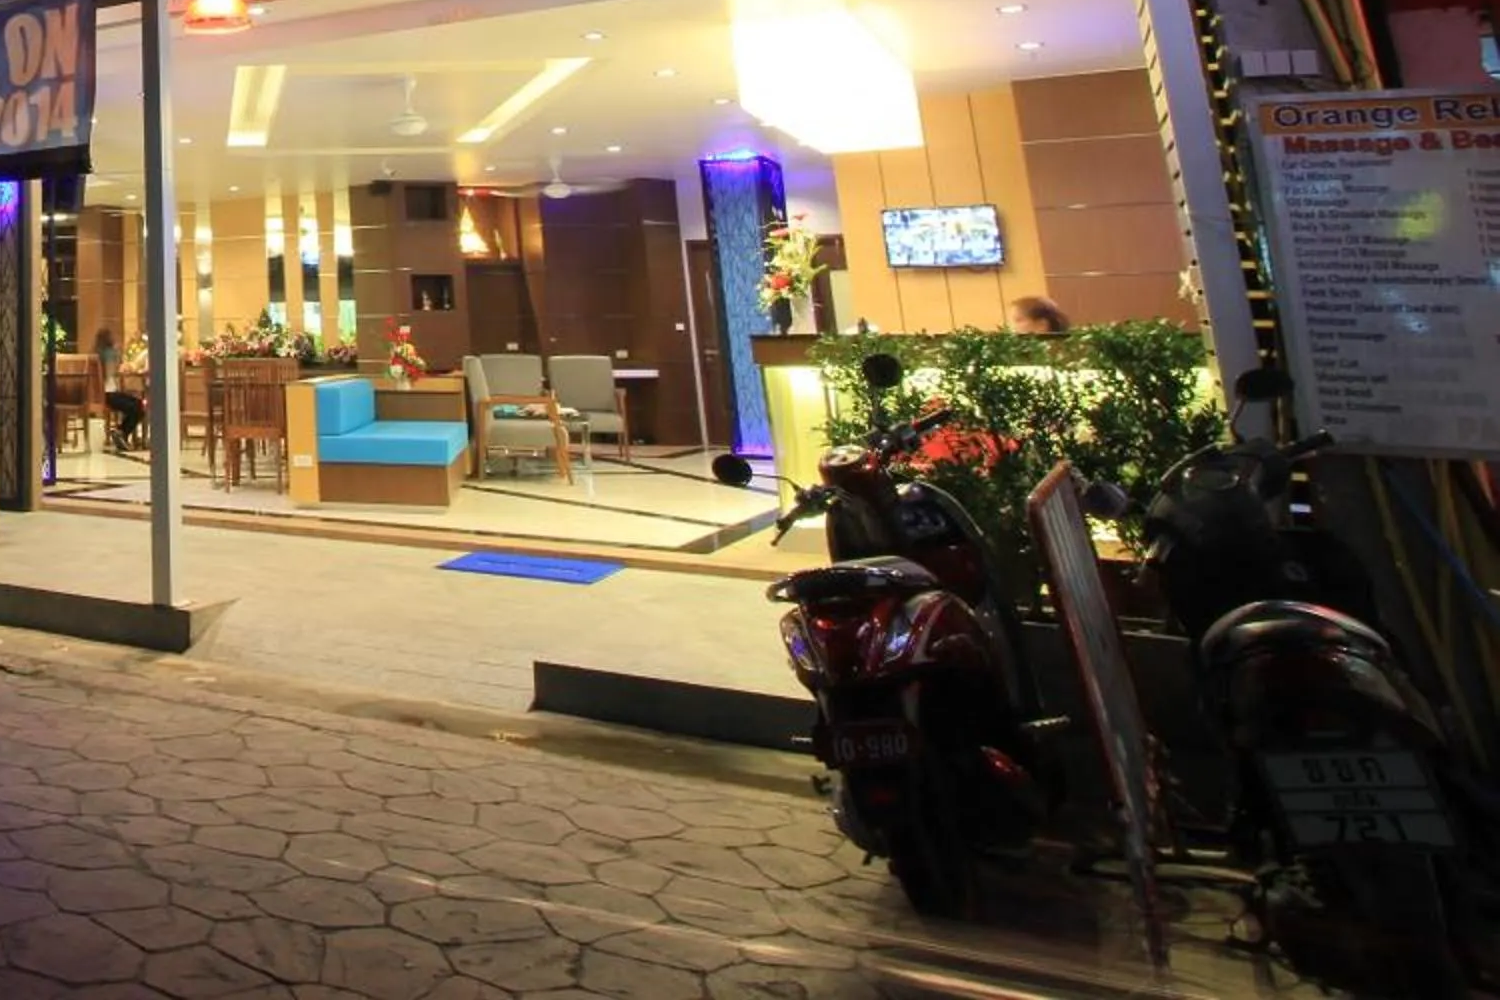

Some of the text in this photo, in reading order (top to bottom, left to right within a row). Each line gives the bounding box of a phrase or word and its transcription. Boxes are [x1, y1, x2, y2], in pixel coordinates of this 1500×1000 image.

[4, 3, 79, 87] ON
[1274, 104, 1417, 129] Orange
[1283, 135, 1411, 156] Massage
[1421, 131, 1442, 151] &
